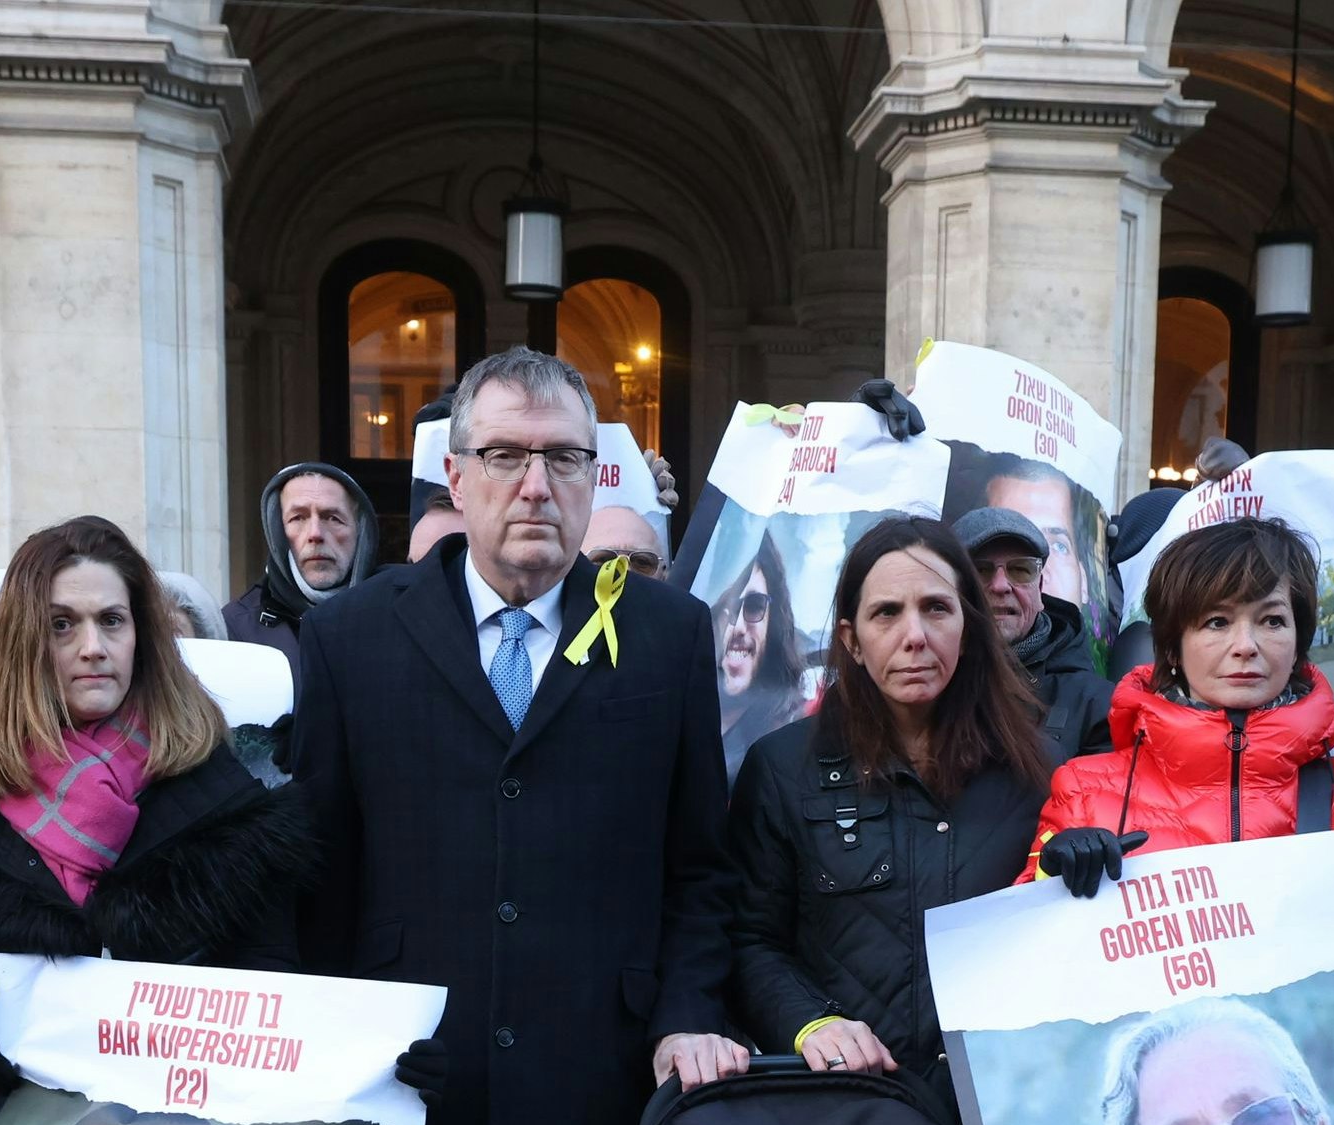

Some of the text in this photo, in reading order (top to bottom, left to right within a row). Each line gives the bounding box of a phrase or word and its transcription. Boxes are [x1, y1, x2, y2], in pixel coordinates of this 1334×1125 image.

[1014, 369, 1046, 403] שאול
[1007, 396, 1077, 448] ORON SHAUL
[1034, 429, 1058, 462] (30)
[1117, 866, 1218, 920] מיה גורן
[1100, 902, 1256, 963] GOREN MAYA
[1163, 948, 1216, 996] (56)
[126, 980, 281, 1030] בר קופרשטיין
[98, 1020, 302, 1073] BAR KUPERSHTEIN
[166, 1065, 208, 1109] (22)
